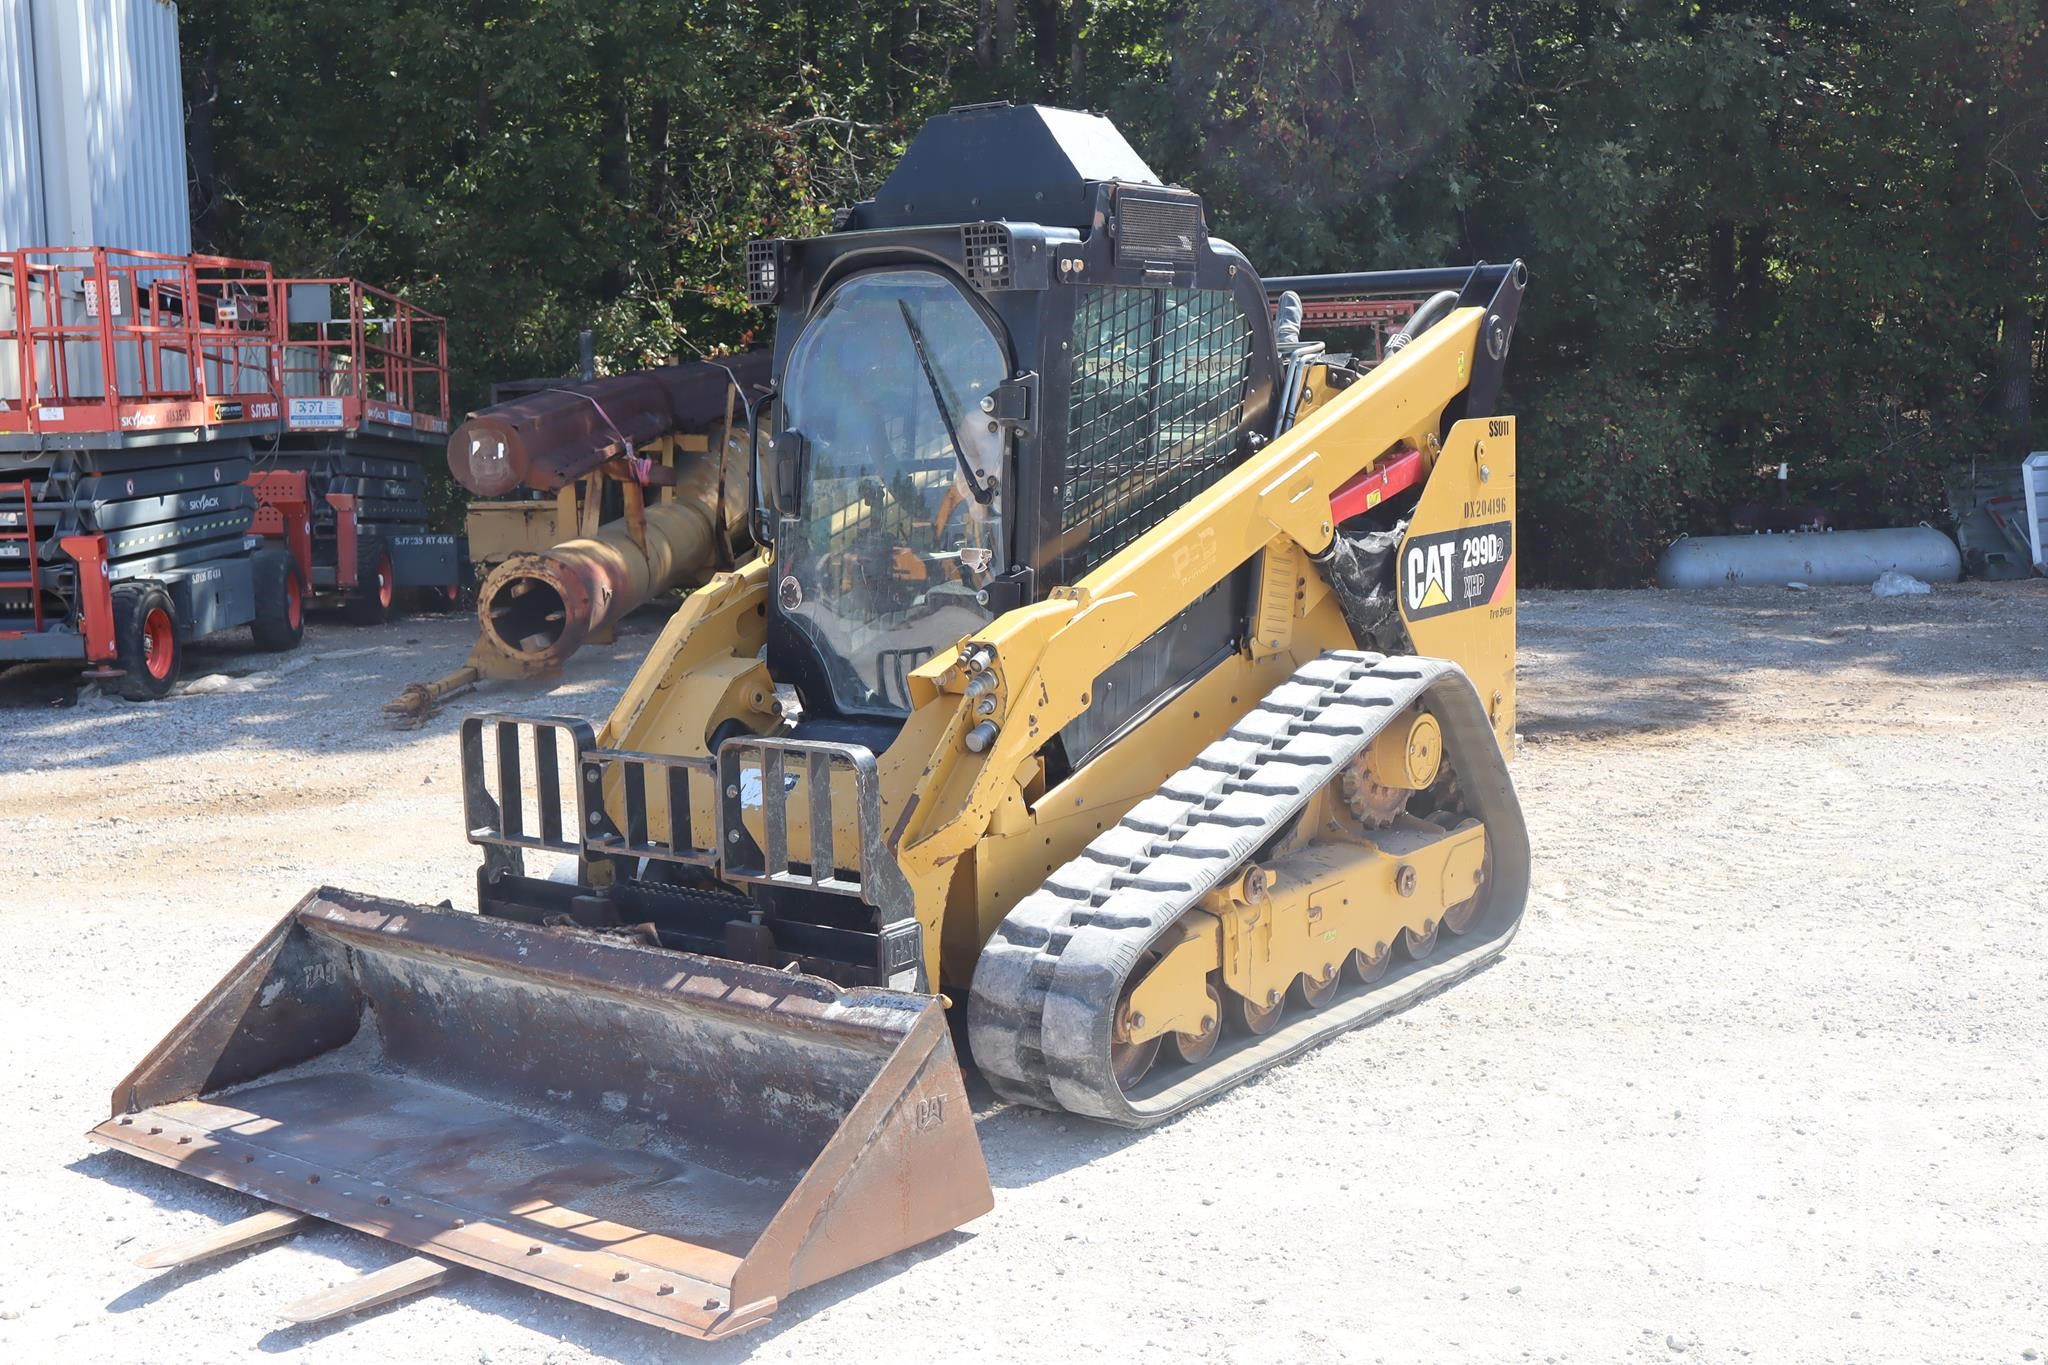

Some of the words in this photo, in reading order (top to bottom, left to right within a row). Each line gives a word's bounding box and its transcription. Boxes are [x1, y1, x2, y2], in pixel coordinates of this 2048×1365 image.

[121, 411, 156, 428] SKYJACK
[189, 494, 220, 511] SKYJACK
[437, 536, 454, 545] 4X4
[1462, 533, 1504, 569] 299D2
[1407, 541, 1456, 611] CAT
[1463, 573, 1485, 599] XHP
[916, 1093, 948, 1131] CAT
